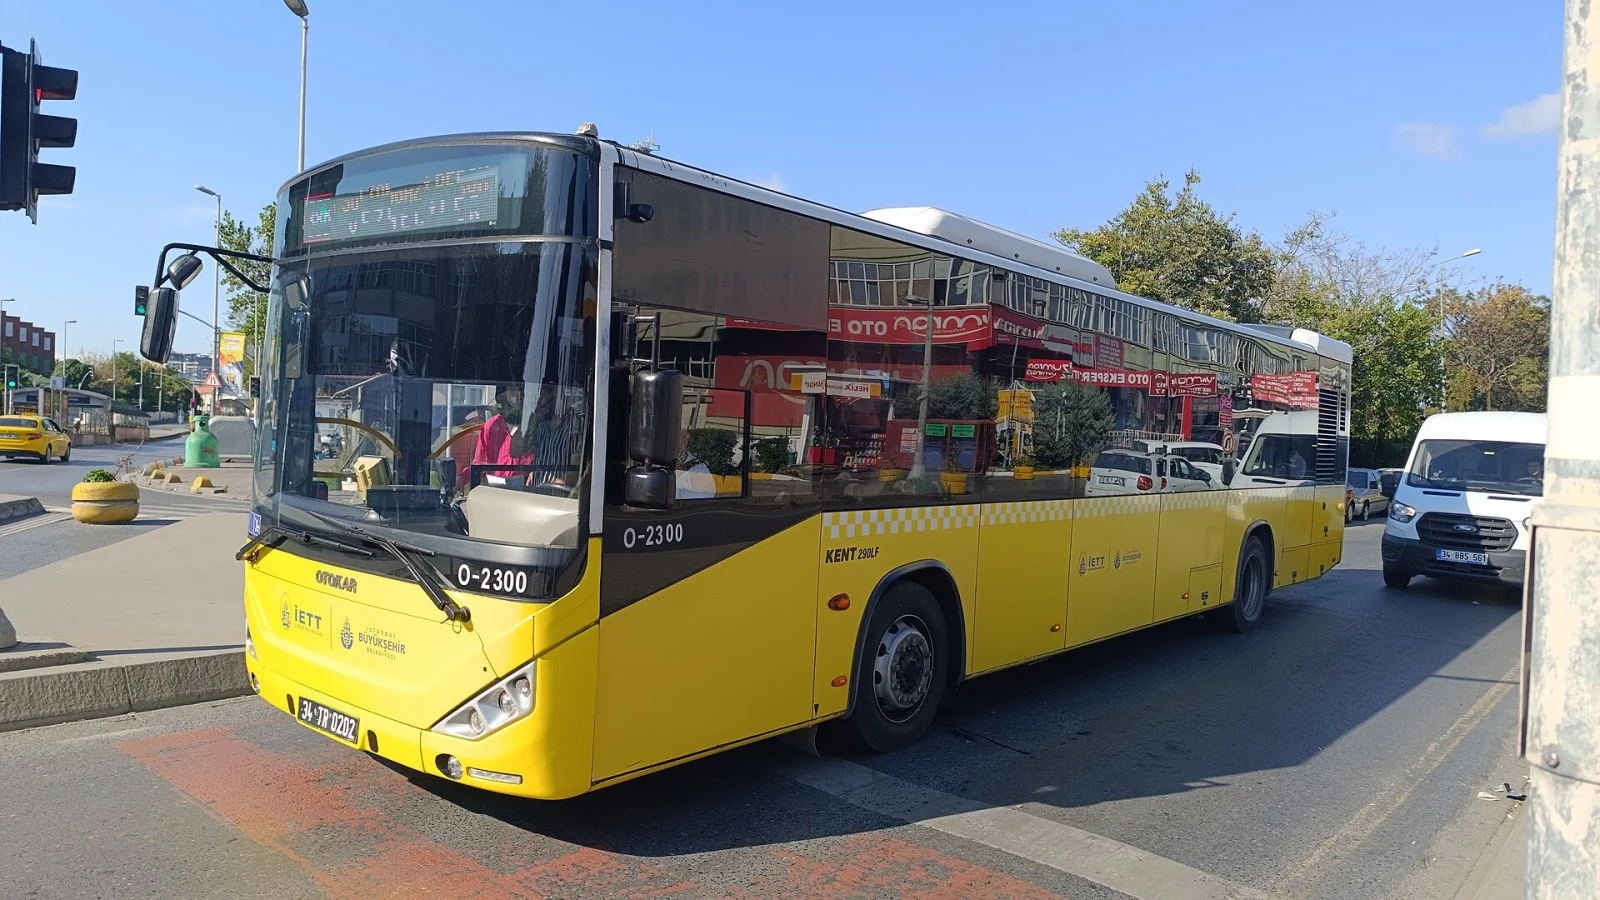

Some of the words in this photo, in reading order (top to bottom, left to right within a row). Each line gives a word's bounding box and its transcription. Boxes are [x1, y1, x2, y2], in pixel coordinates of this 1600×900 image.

[623, 523, 684, 549] O-2300
[825, 547, 858, 564] KENT
[858, 546, 880, 560] 290LF
[1441, 550, 1451, 558] 34
[1472, 553, 1486, 563] 561
[315, 569, 358, 594] OTOKAR
[457, 563, 528, 594] O-2300
[294, 604, 322, 630] İETT
[358, 631, 406, 655] BÜYÜKŞEHİR
[301, 700, 314, 722] 34
[317, 705, 329, 729] TR
[330, 711, 357, 741] 0202
